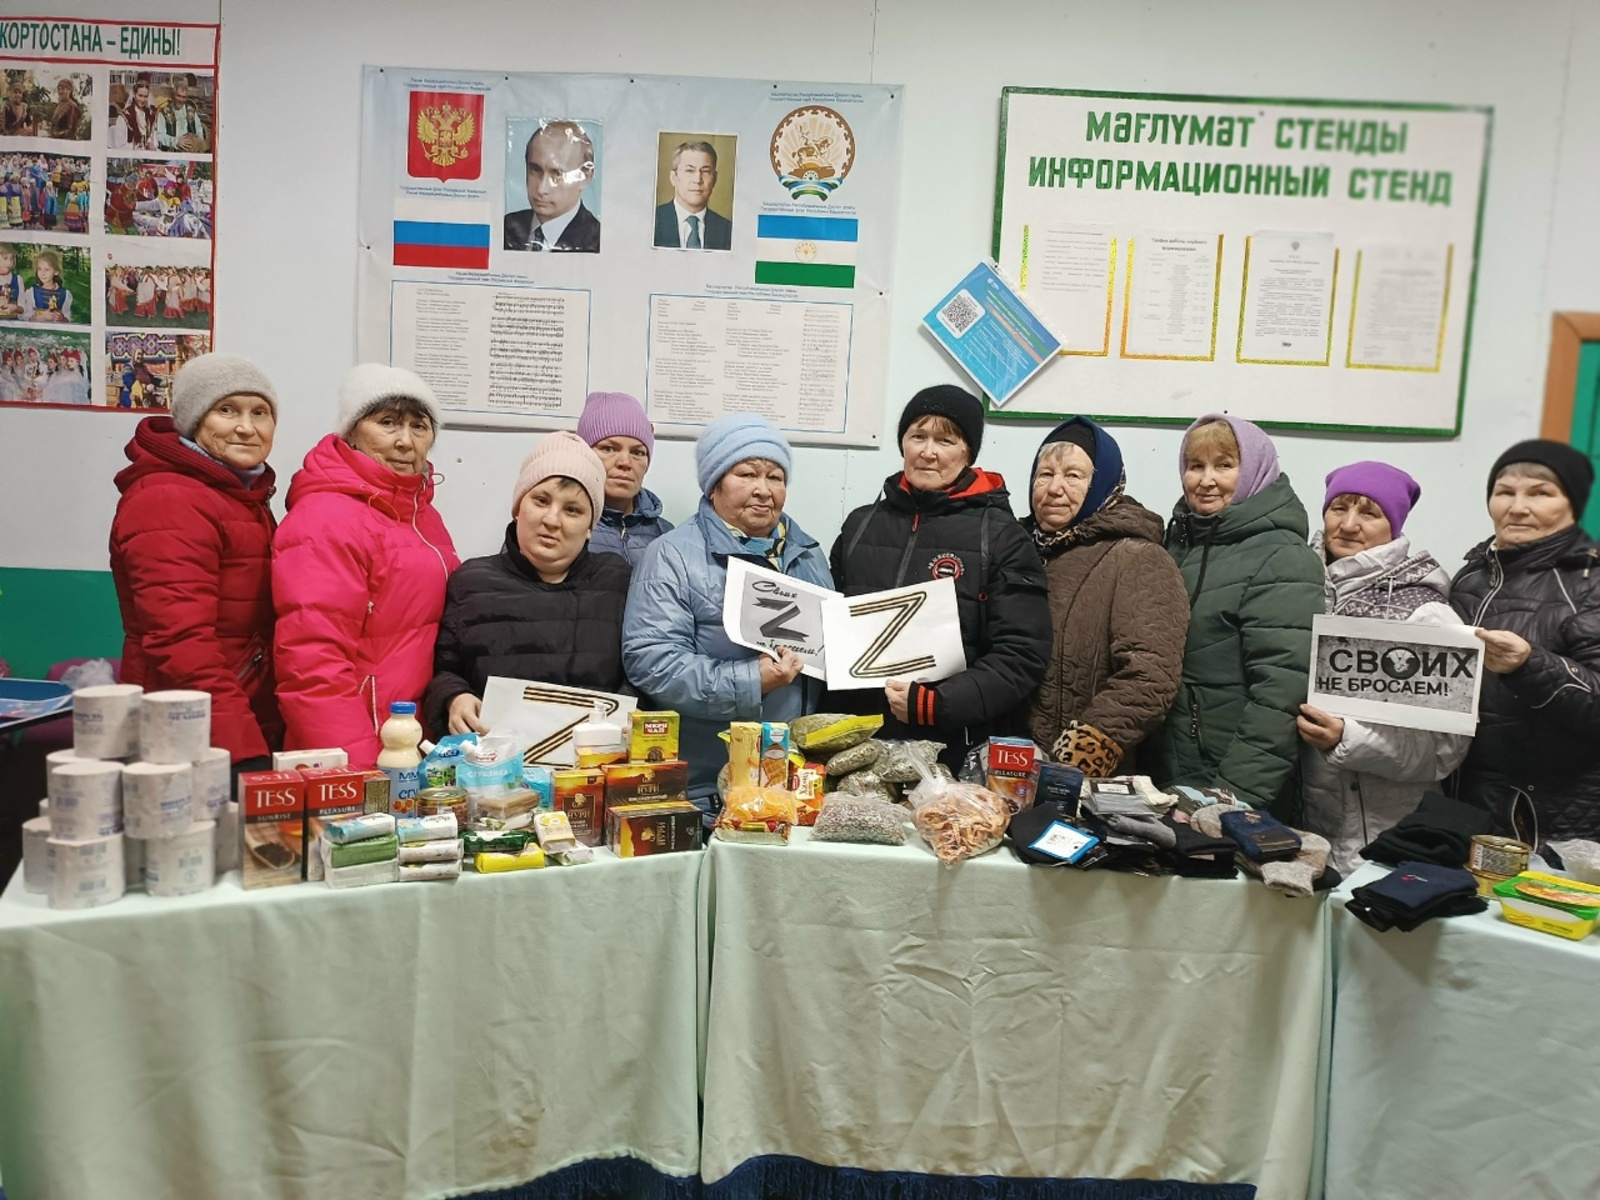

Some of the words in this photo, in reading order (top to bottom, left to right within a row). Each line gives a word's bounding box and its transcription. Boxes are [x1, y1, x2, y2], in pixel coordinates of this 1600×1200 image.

[0, 22, 103, 53] КОРТОСТАНА
[120, 26, 181, 59] ЕДИНЫ!
[1275, 117, 1408, 157] СТЕНДЫ
[1028, 156, 1331, 198] ИНФОРМАЦИОННЫЙ
[1348, 168, 1453, 207] СТЕНД
[1329, 646, 1474, 680] СВОИХ
[1318, 677, 1342, 691] НЕ
[1348, 678, 1449, 697] БРОСАЕМ!
[996, 749, 1029, 767] TESS
[994, 770, 1027, 778] PLEASURE
[254, 788, 297, 808] TESS
[317, 781, 358, 802] TESS
[257, 813, 292, 821] SUNRISE
[319, 806, 356, 815] PLEASURE
